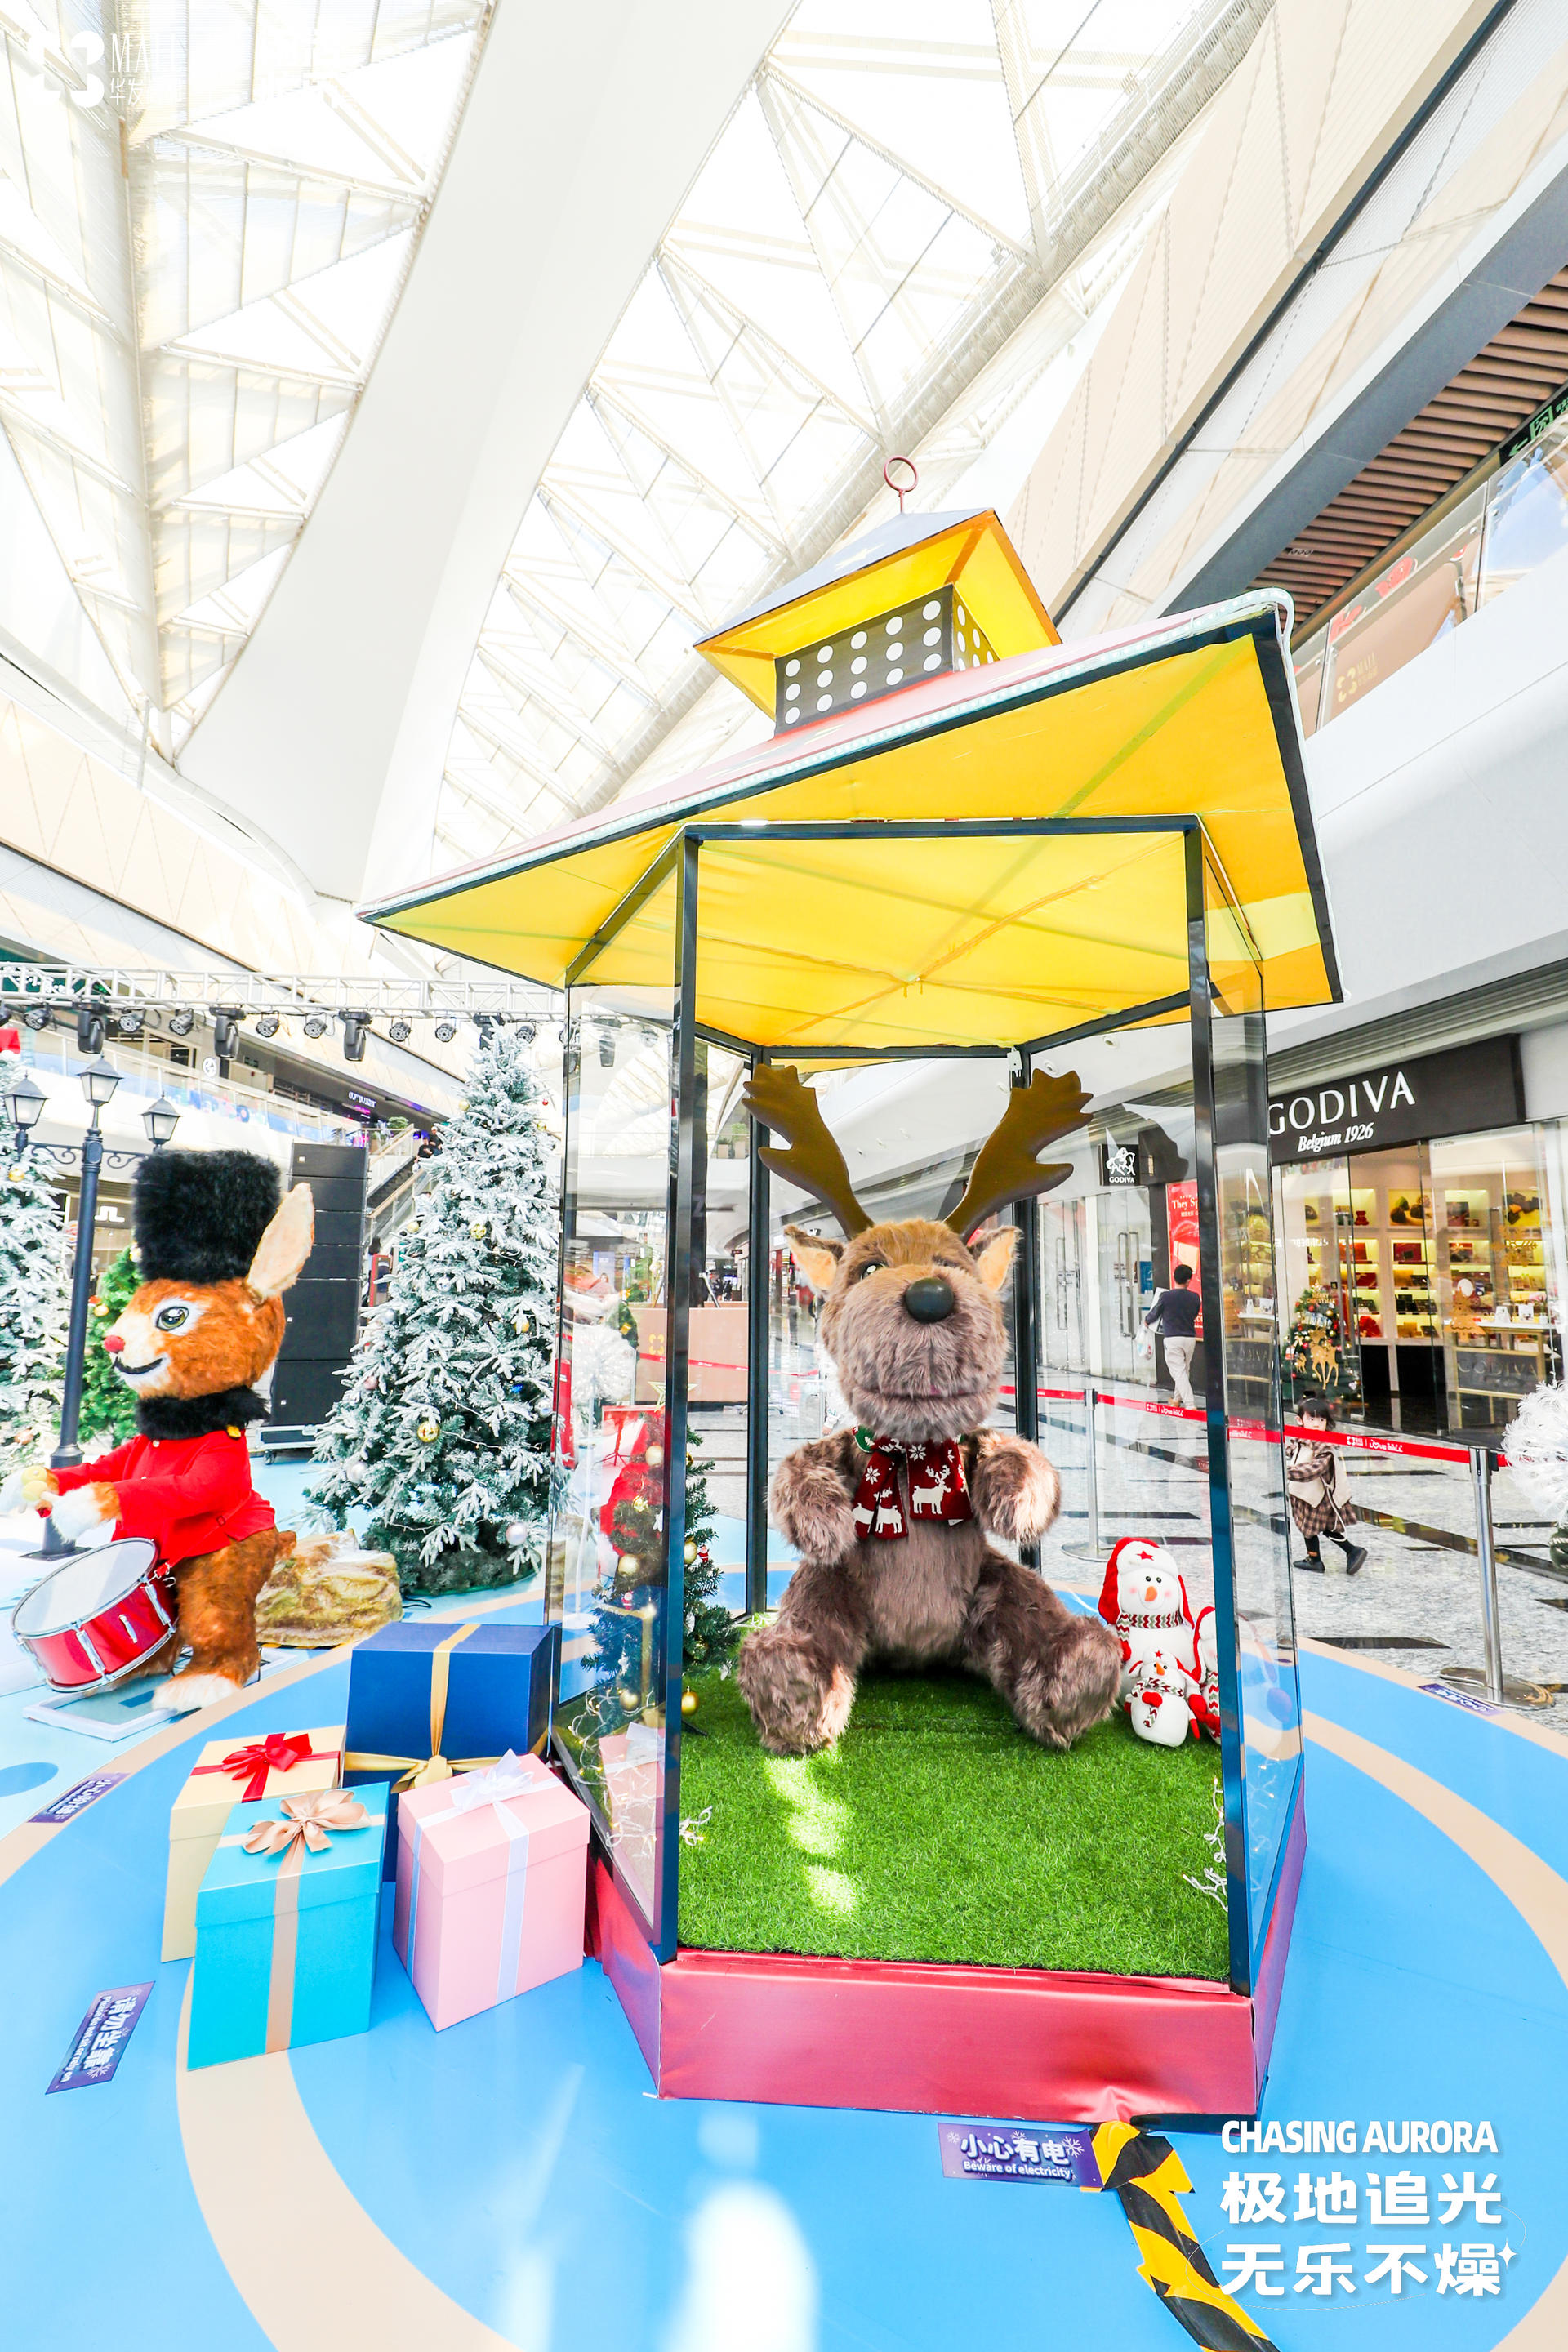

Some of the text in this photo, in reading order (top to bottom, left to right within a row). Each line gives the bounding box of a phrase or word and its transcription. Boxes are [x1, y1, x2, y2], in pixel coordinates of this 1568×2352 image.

[1268, 1071, 1416, 1136] GODIVA
[1298, 1122, 1374, 1152] Belgium 1926
[60, 1995, 112, 2083] Please do not sit or rely on
[82, 1996, 138, 2070] 请勿坐靠
[960, 2133, 1071, 2165] 小心有电
[964, 2160, 1072, 2180] Beware of electricity
